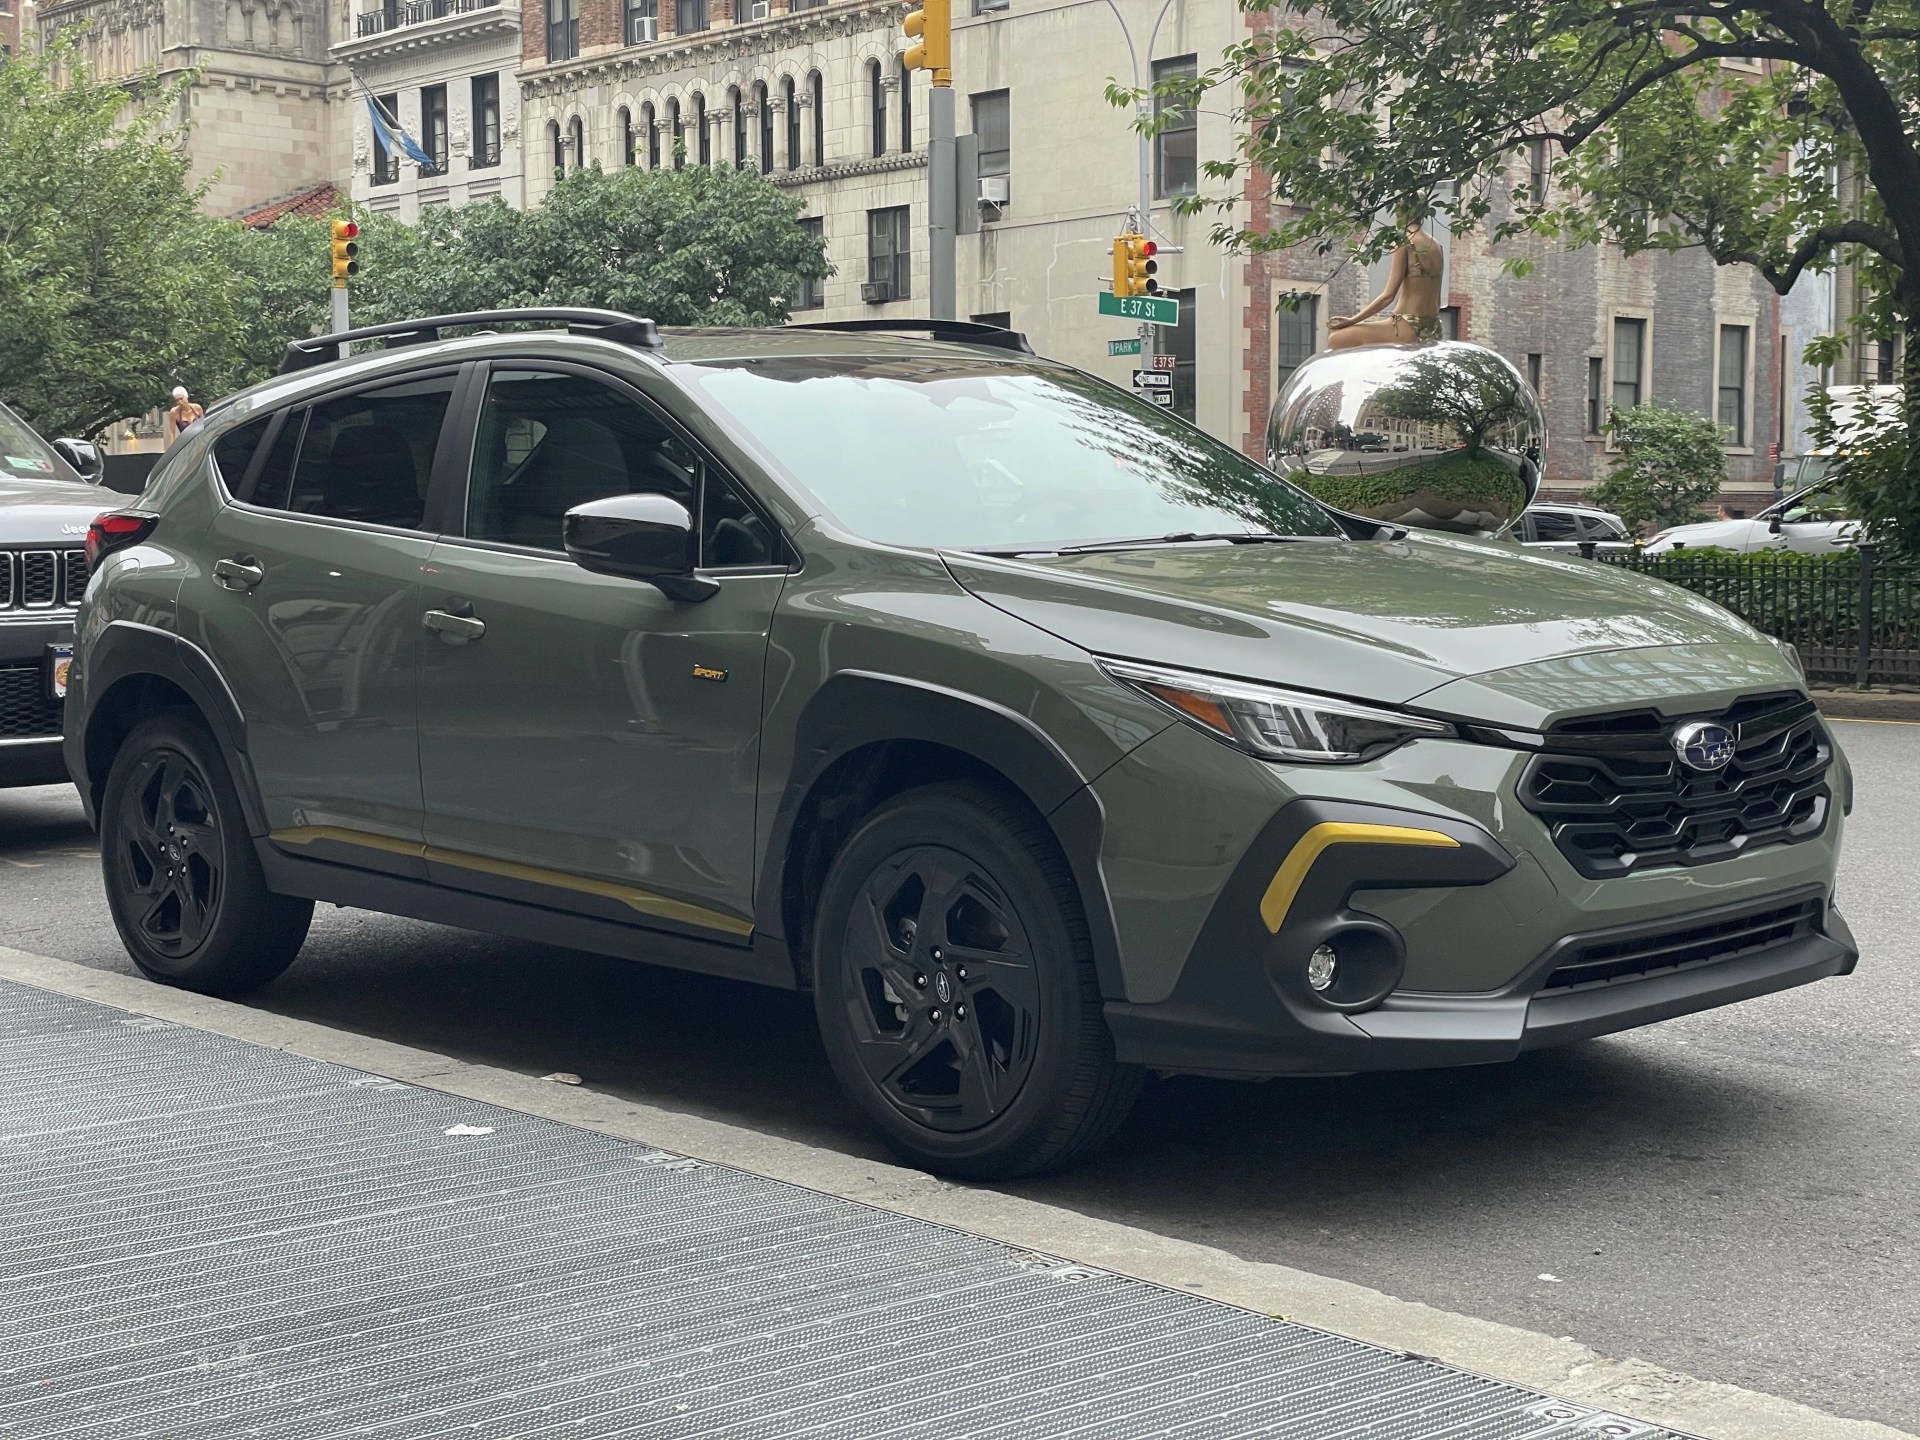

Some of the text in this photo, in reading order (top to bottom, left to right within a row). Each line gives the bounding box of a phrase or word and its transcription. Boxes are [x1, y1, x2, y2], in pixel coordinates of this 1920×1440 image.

[1121, 298, 1155, 317] E 37 St
[1115, 342, 1133, 353] PARK
[1153, 356, 1175, 367] E 37 ST
[1139, 375, 1167, 384] ONE WAY
[1154, 396, 1167, 404] WAY
[693, 667, 724, 679] SPORT
